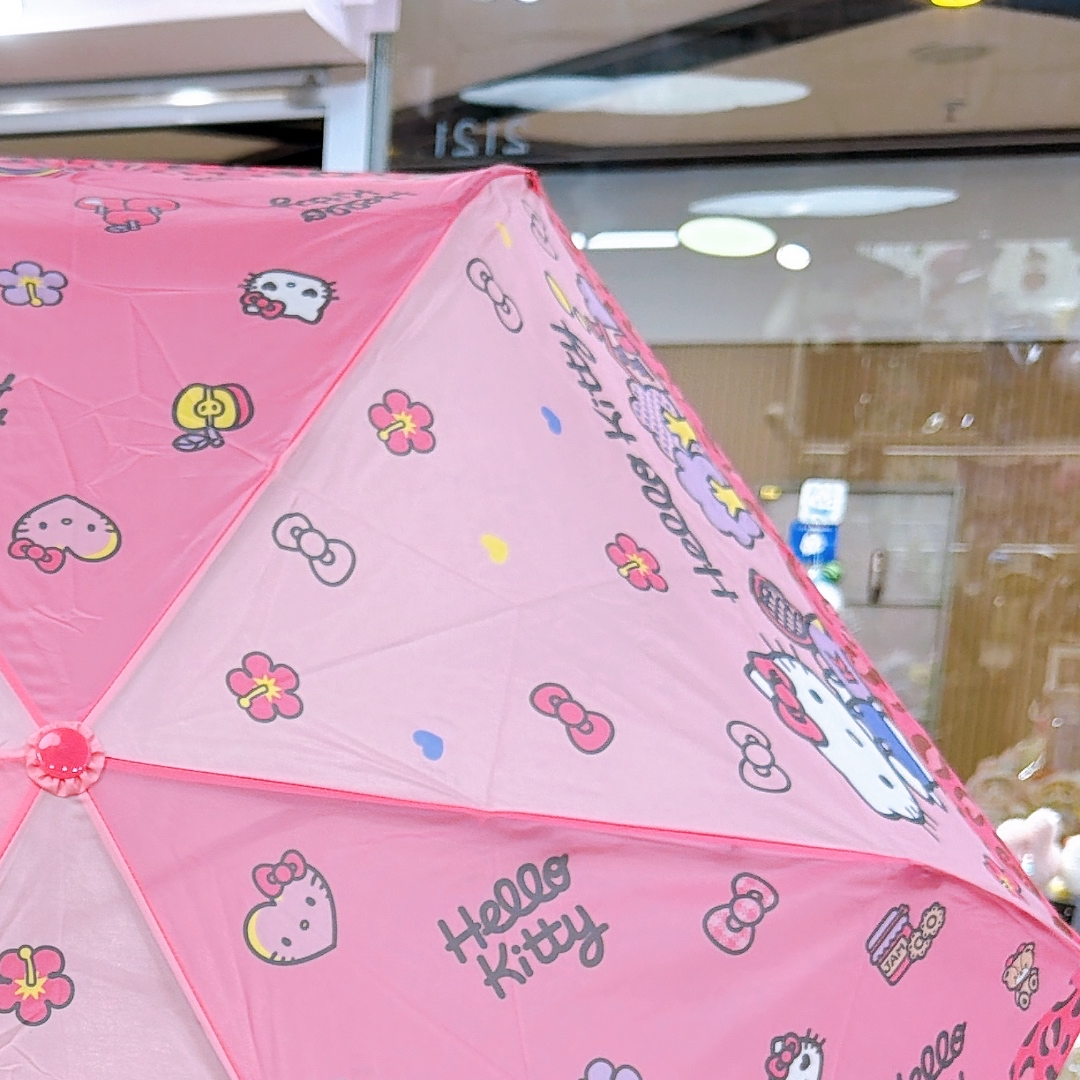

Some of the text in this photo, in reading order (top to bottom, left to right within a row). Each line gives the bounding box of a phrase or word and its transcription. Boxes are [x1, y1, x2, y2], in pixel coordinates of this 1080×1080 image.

[550, 319, 739, 603] Hello Kitty
[436, 853, 573, 964] Hello
[475, 903, 610, 1000] Kitty
[883, 943, 906, 974] JAM
